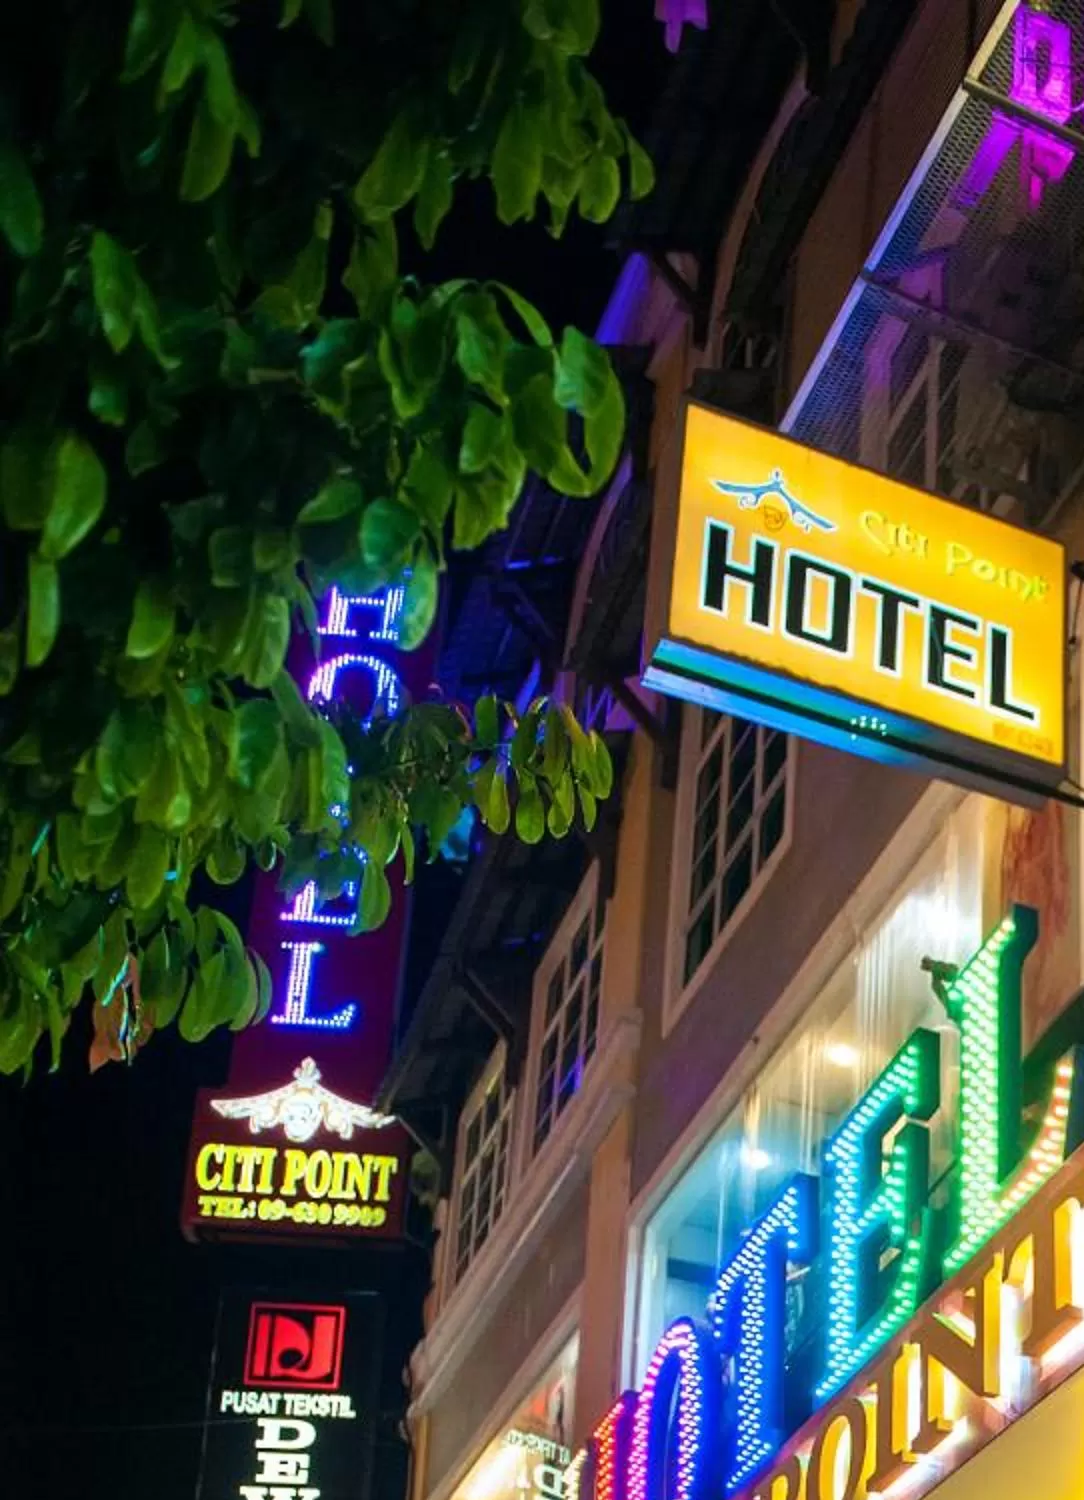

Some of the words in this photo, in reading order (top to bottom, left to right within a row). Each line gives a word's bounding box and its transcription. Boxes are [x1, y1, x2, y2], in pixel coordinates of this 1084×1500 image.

[700, 517, 1040, 727] HOTEL
[196, 1144, 277, 1194] CITI
[280, 1149, 398, 1201] POINT
[221, 1391, 281, 1415] PUSAT
[284, 1393, 356, 1418] TEKSTIL
